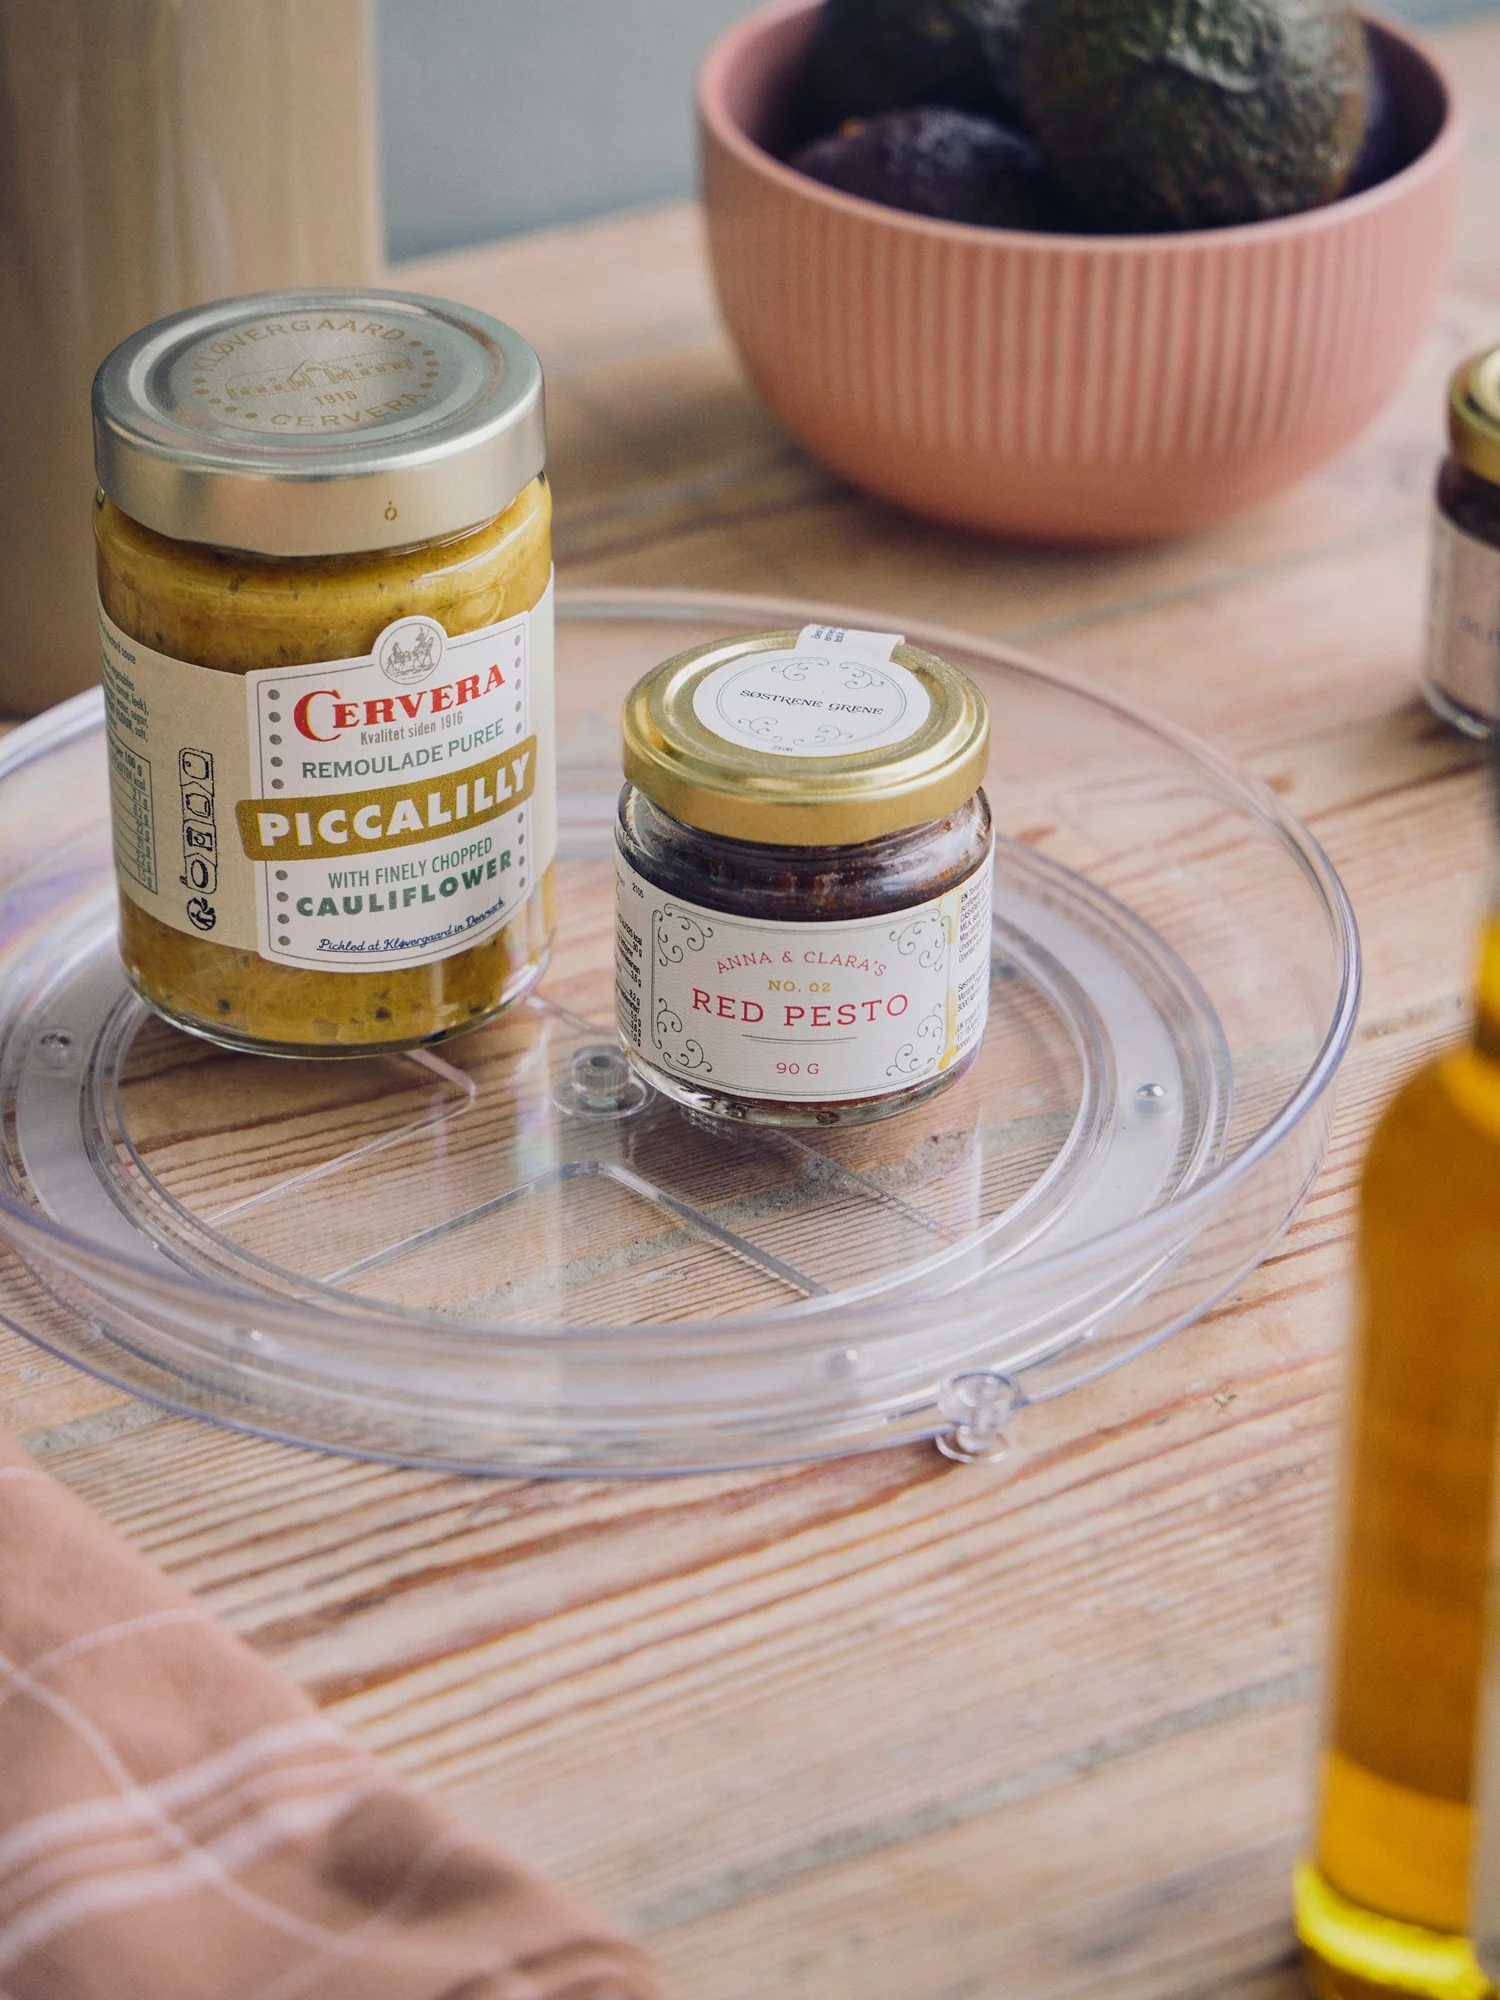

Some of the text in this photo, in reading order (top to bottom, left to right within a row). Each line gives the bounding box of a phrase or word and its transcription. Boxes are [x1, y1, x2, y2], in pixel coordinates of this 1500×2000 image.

[191, 318, 405, 374] KLØVERGAARD
[270, 392, 427, 427] CERVERA
[314, 389, 357, 406] 1916
[740, 689, 883, 715] SØSTRENE GRENE
[360, 710, 463, 745] Kvalitet siden 1916
[302, 718, 504, 779] REMOULADE PUREE
[258, 751, 531, 847] PICCALILLY
[296, 850, 512, 916] CAULIFLOWER
[328, 840, 492, 889] WITH FINELY CHOPPED
[319, 896, 506, 951] Pickled at Kløvergaard in Denmark
[717, 951, 772, 975] ANNA
[782, 951, 794, 963] &
[768, 980, 831, 992] NO. 02
[691, 988, 909, 1027] RED PESTO
[776, 1063, 820, 1075] 90 G
